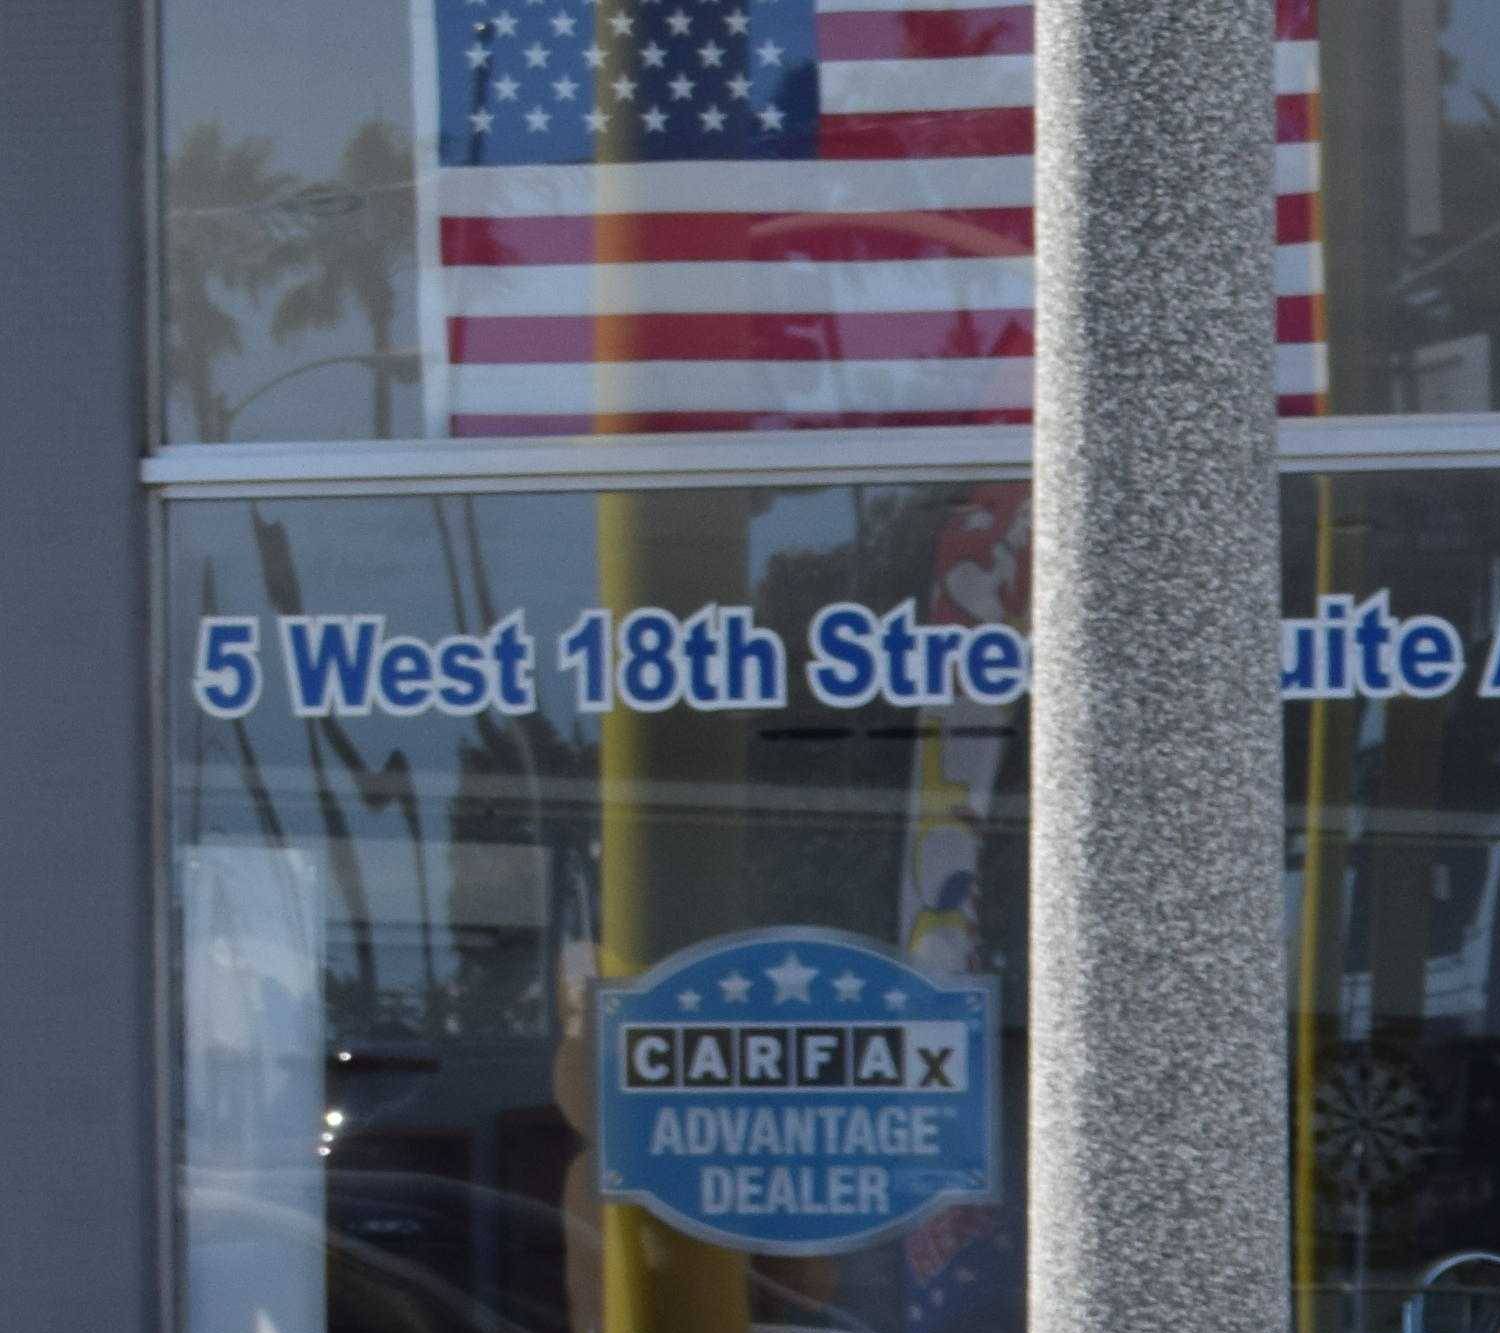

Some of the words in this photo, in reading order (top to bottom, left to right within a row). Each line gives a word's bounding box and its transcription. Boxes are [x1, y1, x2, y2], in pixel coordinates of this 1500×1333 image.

[196, 615, 260, 720] 5
[278, 608, 537, 720] West
[557, 603, 789, 714] 18th
[806, 596, 1032, 709] Stre
[1281, 587, 1467, 701] uite
[628, 1030, 956, 1090] CARFAX
[648, 1104, 942, 1158] ADVANTAGE
[699, 1166, 892, 1216] DEALER
